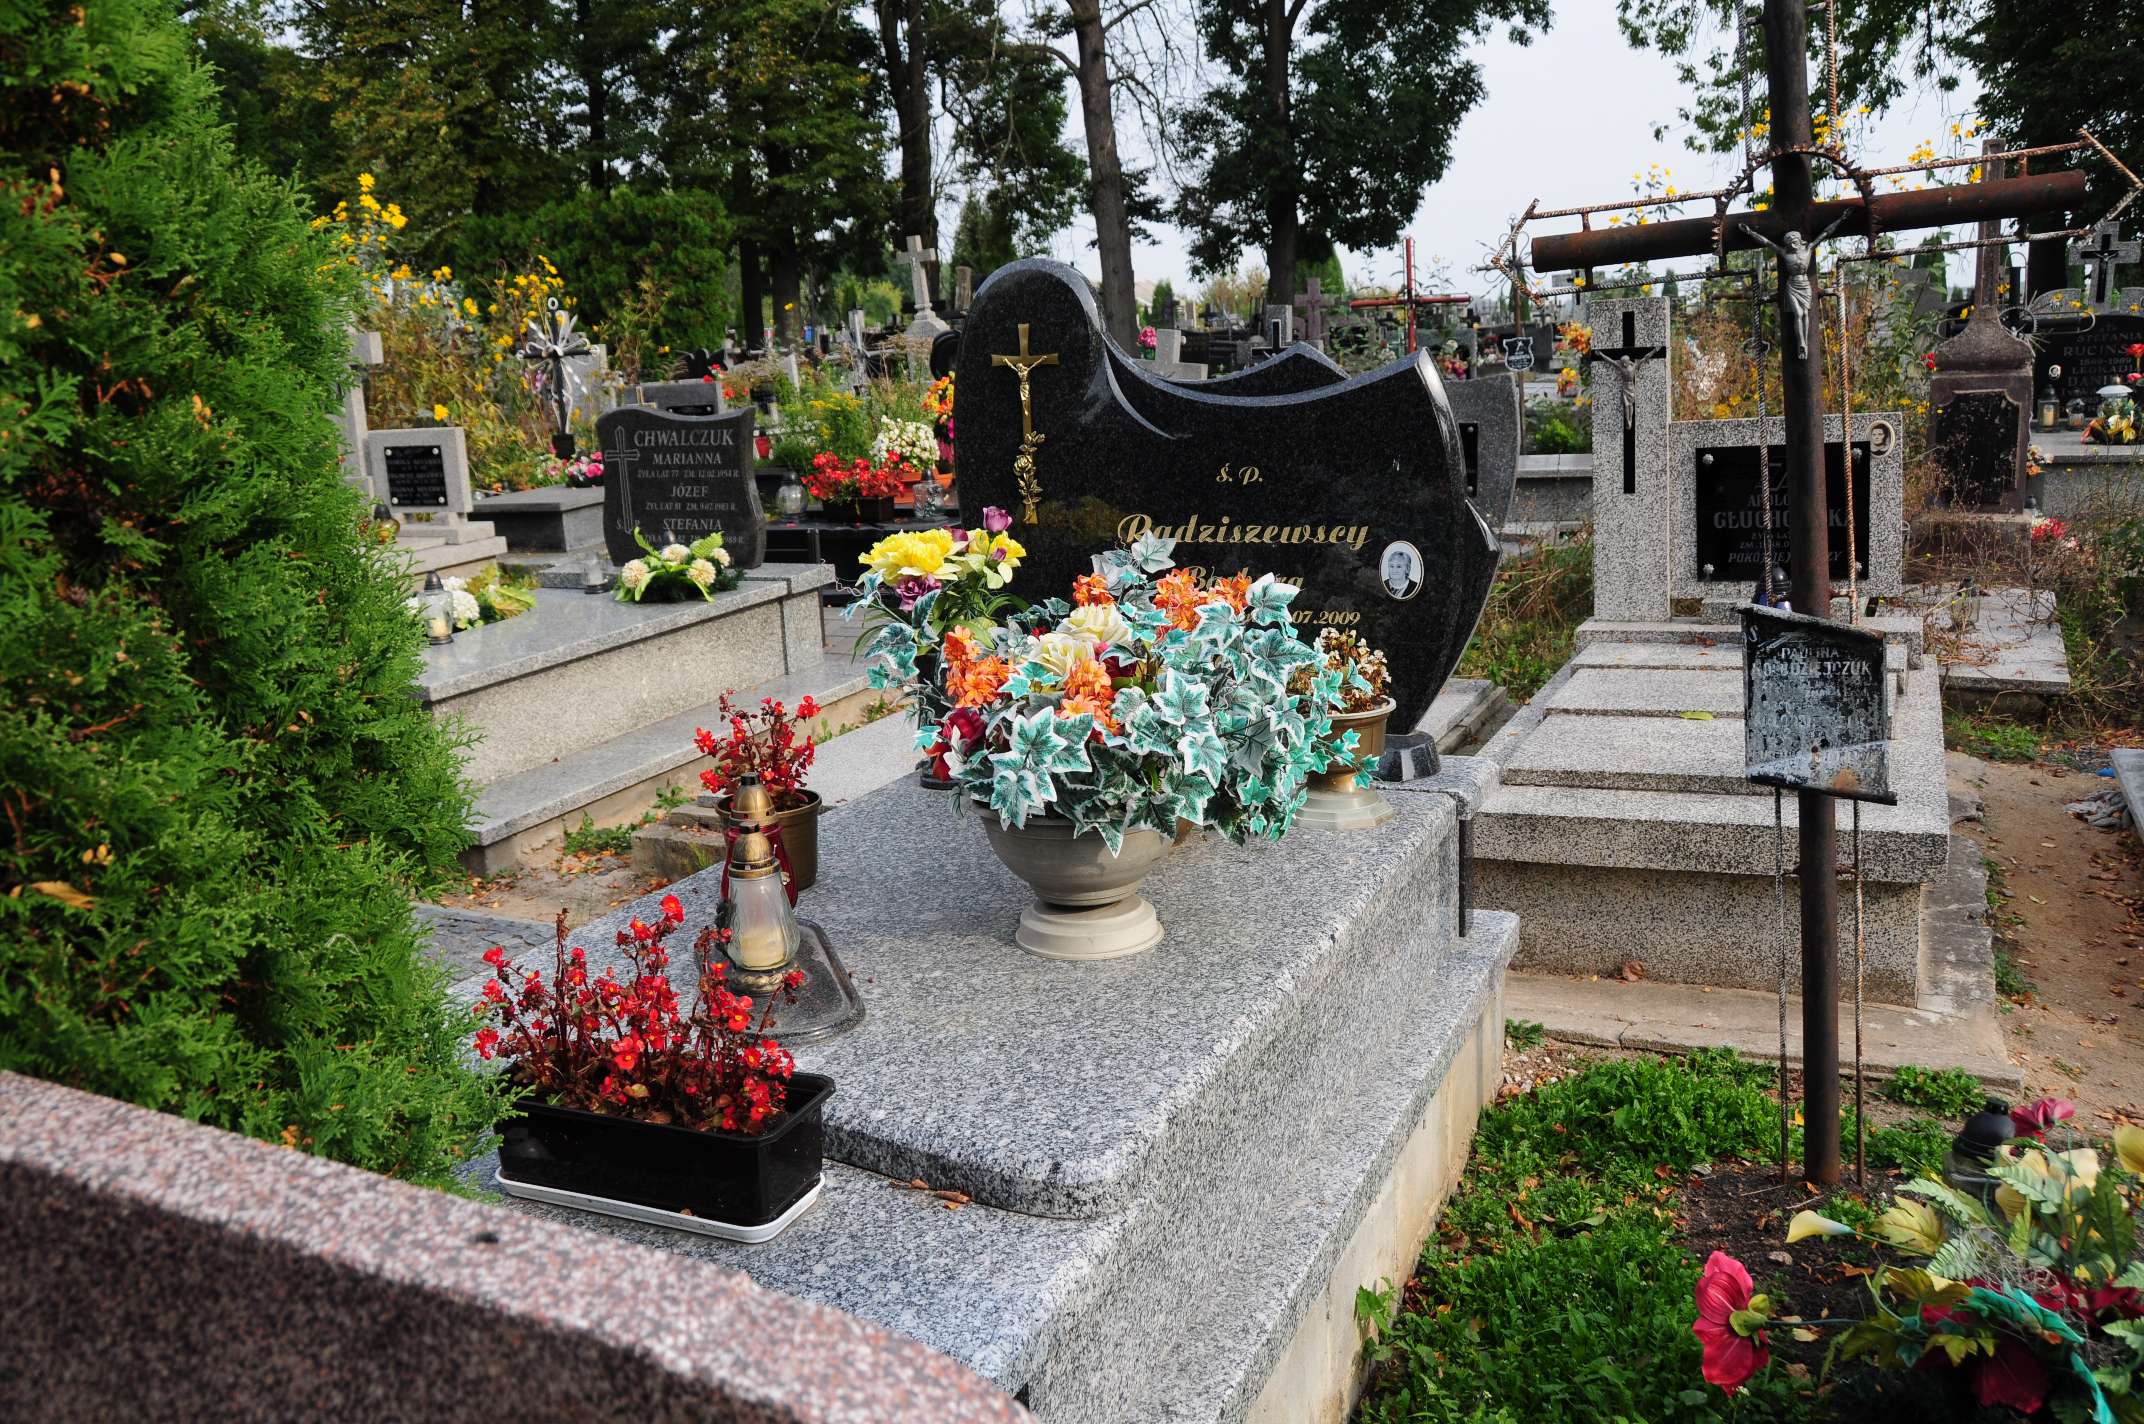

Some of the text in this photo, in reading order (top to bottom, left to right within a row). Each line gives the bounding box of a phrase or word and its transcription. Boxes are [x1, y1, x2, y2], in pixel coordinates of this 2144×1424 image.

[633, 429, 735, 447] CHWALCZUK
[652, 452, 722, 465] MARIANNA
[1216, 462, 1263, 486] Ś. P.
[671, 482, 709, 498] JÓZEF
[663, 518, 722, 530] STEFANIA
[1713, 508, 1853, 529] GŁUCHOK
[1117, 513, 1370, 551] Radziszewscy
[1291, 610, 1361, 625] 07.2009
